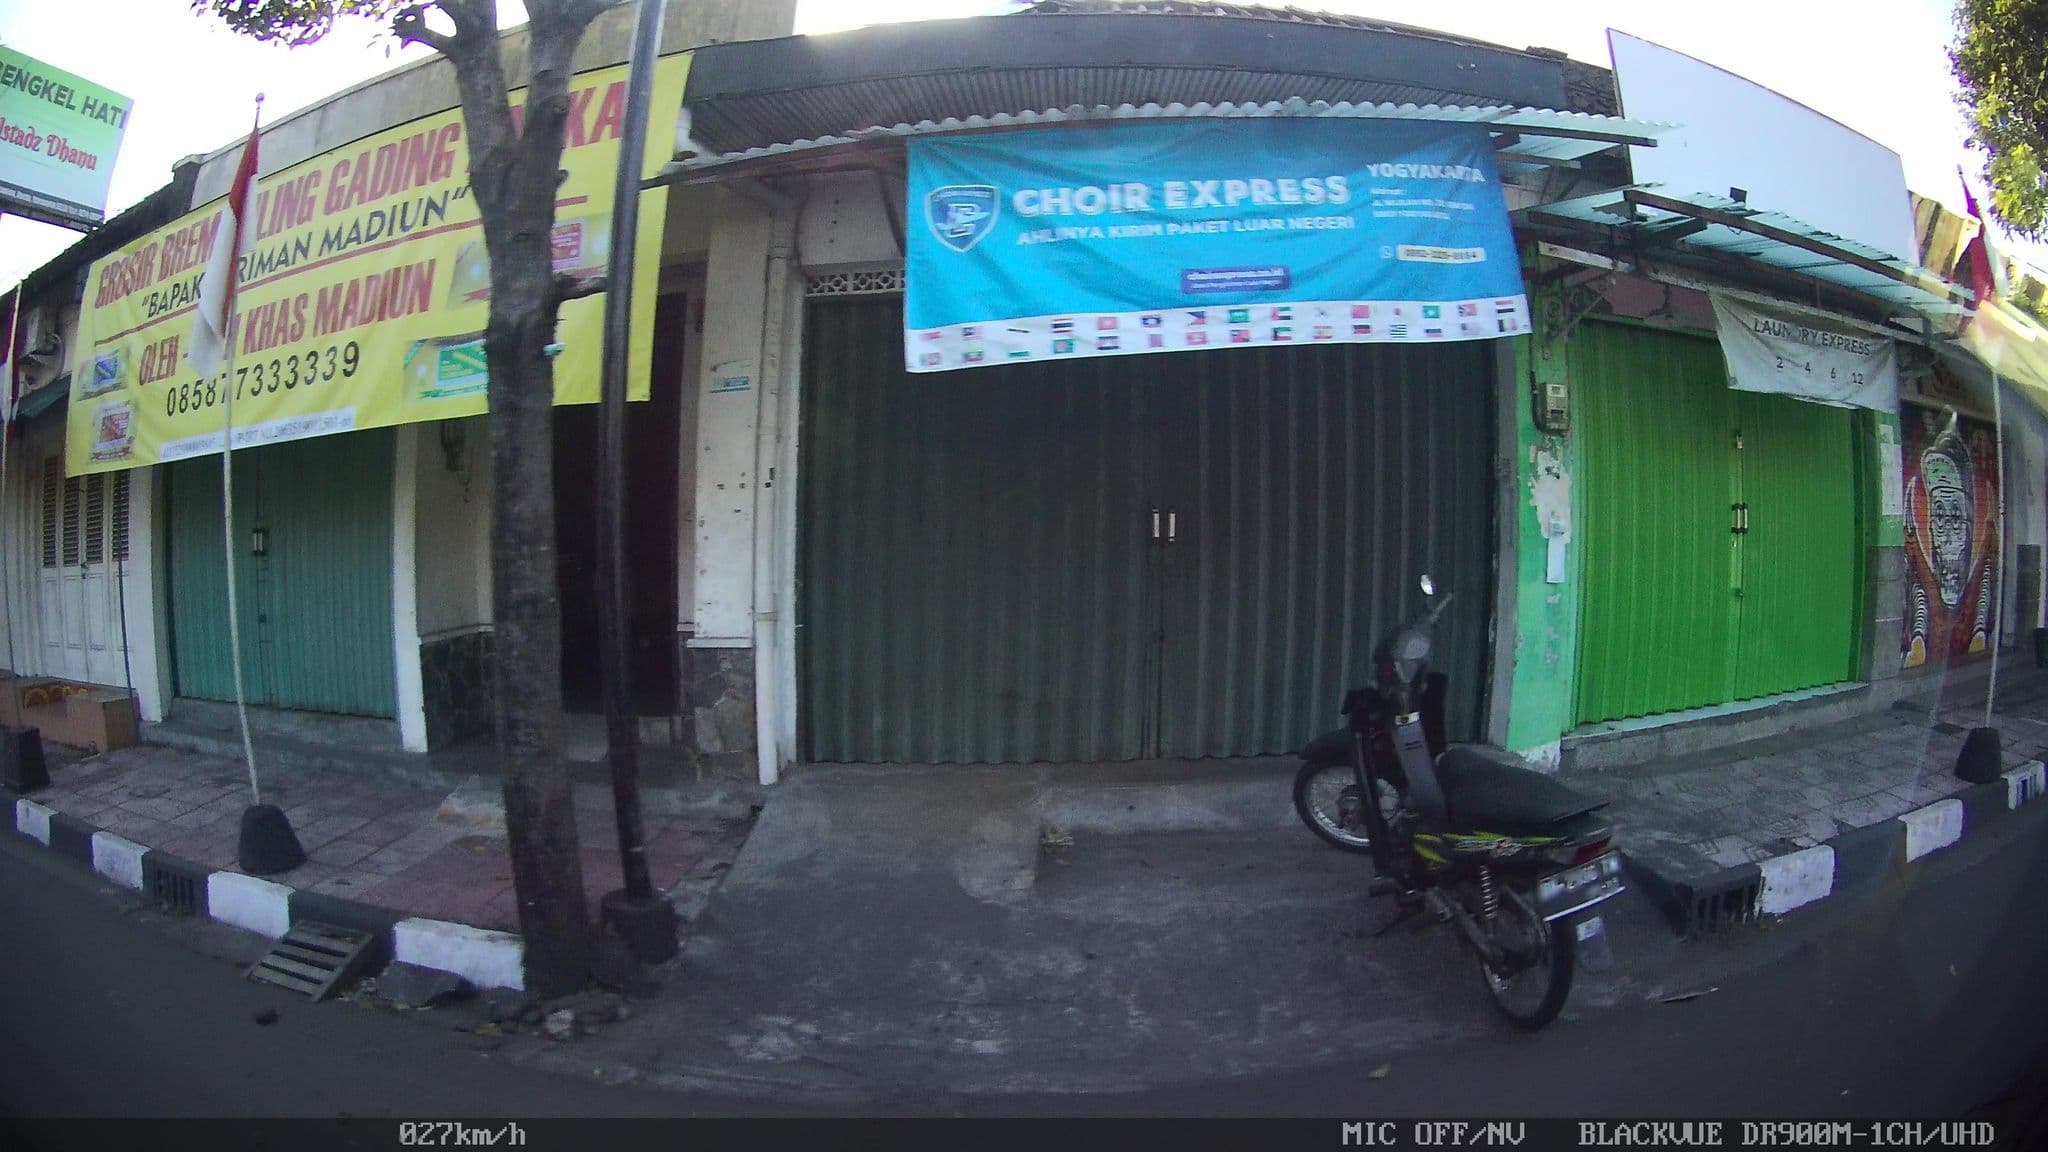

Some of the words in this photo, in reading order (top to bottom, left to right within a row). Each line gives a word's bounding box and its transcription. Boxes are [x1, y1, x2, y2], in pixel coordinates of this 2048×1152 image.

[81, 96, 127, 129] HATI
[47, 134, 97, 171] Dhanu
[323, 122, 461, 216] GADING
[1013, 182, 1154, 217] CHOIR
[1163, 176, 1350, 209] EXPRESS
[1109, 224, 1163, 238] KIRIM
[1167, 220, 1230, 235] PAKET
[1233, 218, 1284, 232] LUAR
[1287, 216, 1355, 230] NEGERI
[139, 335, 180, 386] OLEH
[243, 293, 308, 354] KHAS
[313, 259, 436, 337] MADIUN
[1822, 332, 1870, 356] EXPRESS
[1776, 356, 1784, 369] 2
[1804, 362, 1812, 374] 4
[1830, 367, 1837, 379] 6
[1851, 371, 1865, 385] 12
